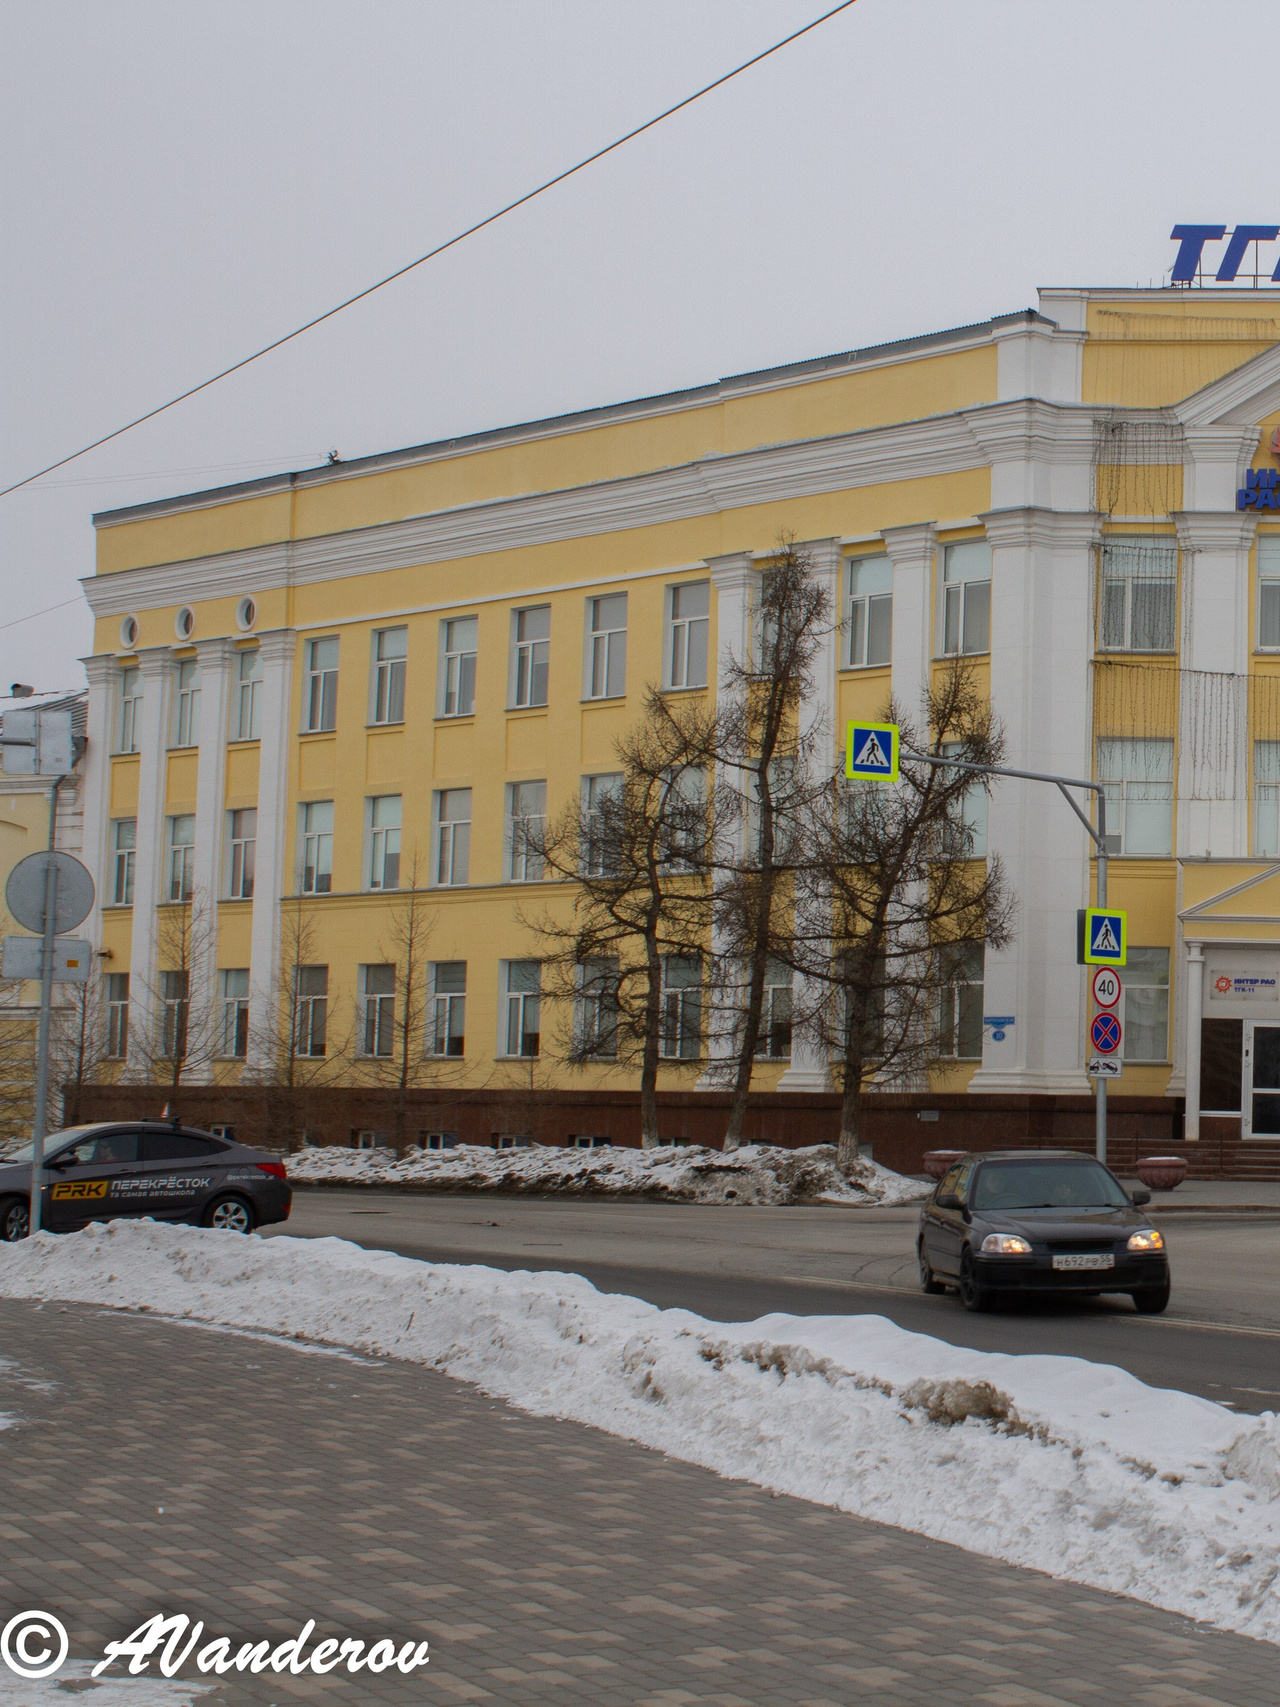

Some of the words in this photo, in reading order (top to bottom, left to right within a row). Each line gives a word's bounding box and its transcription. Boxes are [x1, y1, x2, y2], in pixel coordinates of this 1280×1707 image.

[1098, 979, 1115, 996] 40
[111, 1176, 211, 1190] ПЕРЕКРЁСТОК
[56, 1183, 105, 1198] PRK
[150, 1189, 196, 1197] автошкола
